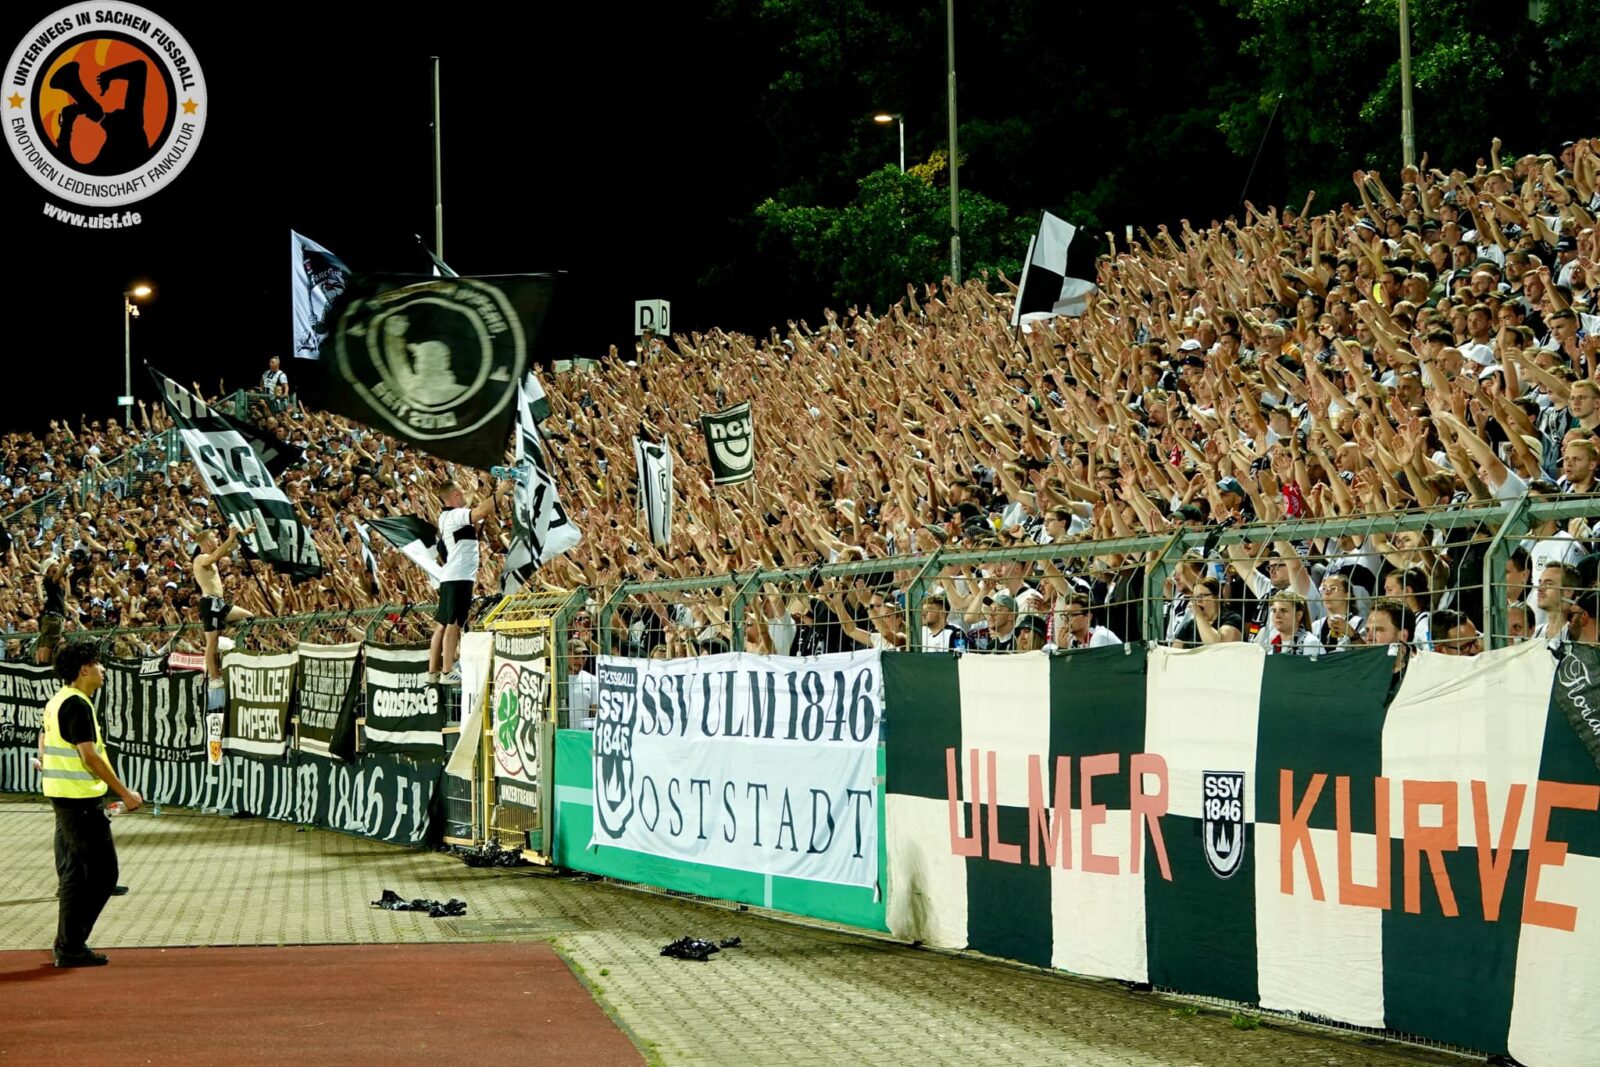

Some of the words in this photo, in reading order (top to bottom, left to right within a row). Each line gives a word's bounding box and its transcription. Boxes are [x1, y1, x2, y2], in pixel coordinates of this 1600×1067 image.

[640, 305, 654, 329] D
[661, 305, 668, 329] D
[228, 666, 291, 703] NEBULOSA
[519, 671, 546, 703] SSV
[600, 669, 636, 688] FUSSBALL
[106, 668, 204, 749] ULTRAS
[237, 705, 283, 740] IMPERO
[600, 689, 635, 727] SSV
[639, 673, 698, 737] SSV
[701, 671, 776, 738] ULM
[783, 668, 875, 742] 1846
[598, 722, 631, 760] 1846
[1205, 776, 1242, 799] SSV
[638, 775, 873, 859] OSTSTADT
[1205, 798, 1242, 822] 1846
[945, 747, 1174, 882] ULMER
[1280, 768, 1600, 933] KURVE
